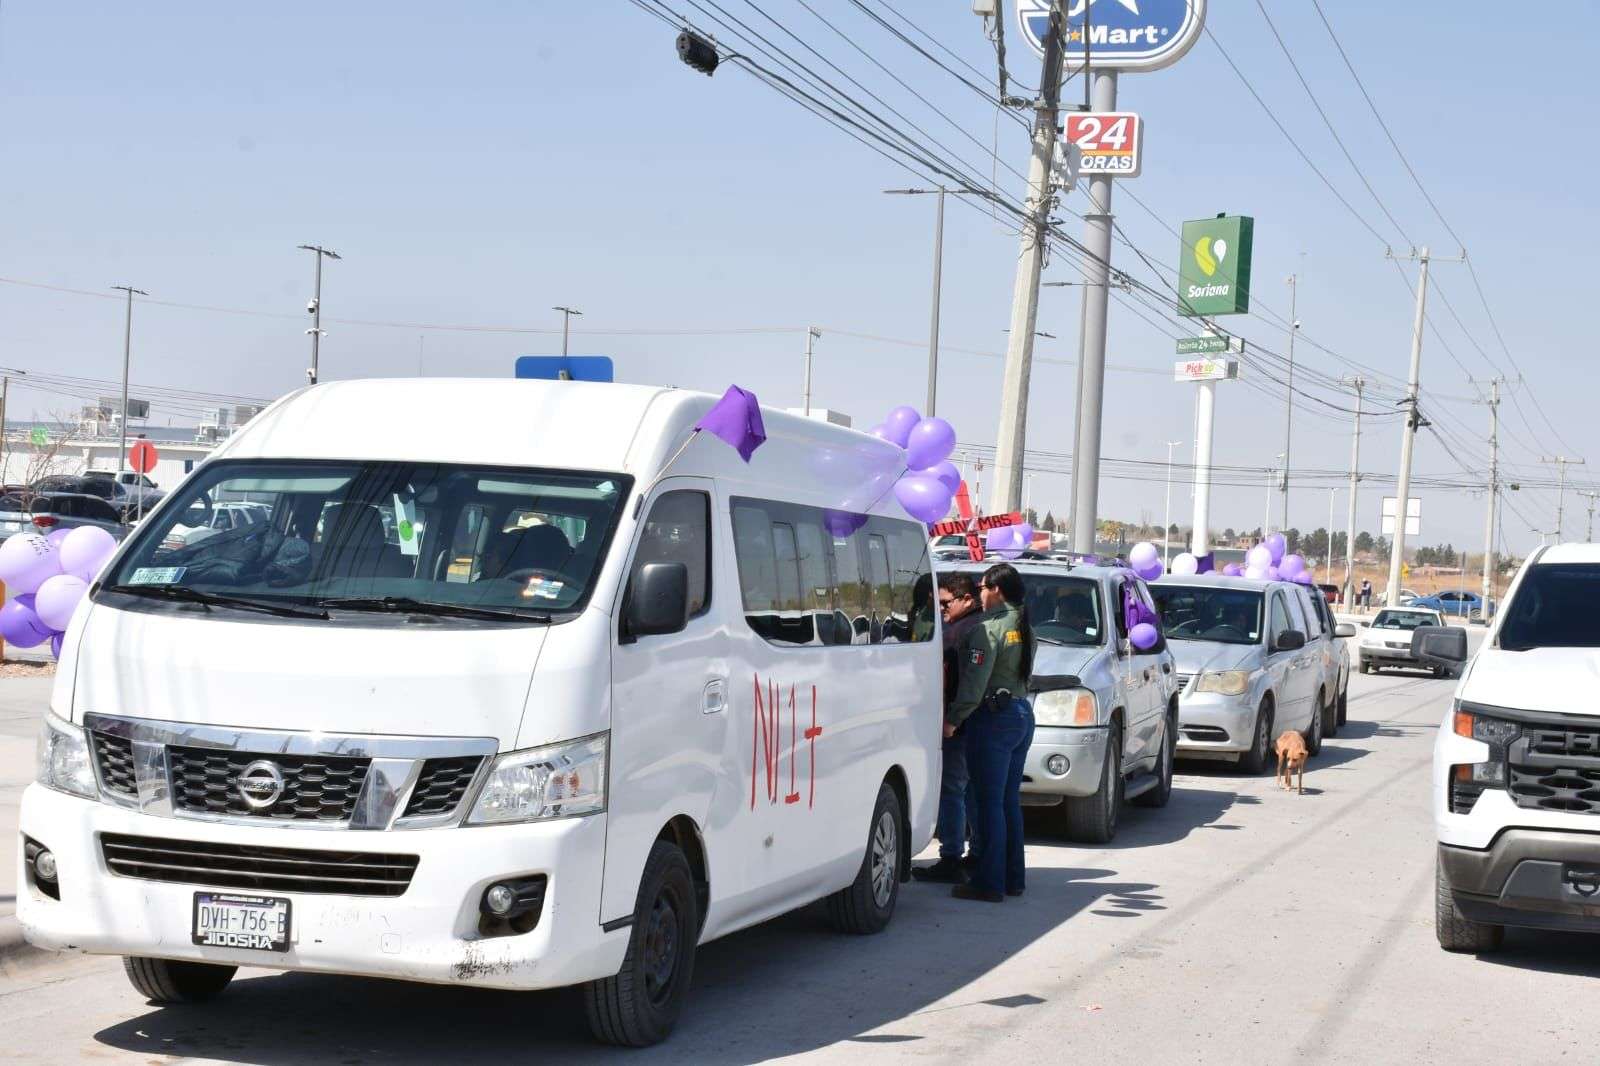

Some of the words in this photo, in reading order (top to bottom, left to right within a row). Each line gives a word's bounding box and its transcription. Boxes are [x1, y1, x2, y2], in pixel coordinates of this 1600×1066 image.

[1076, 117, 1128, 150] 24
[1080, 155, 1132, 170] ORAS
[1187, 283, 1230, 299] Soriana
[200, 906, 286, 934] DVH-756-B
